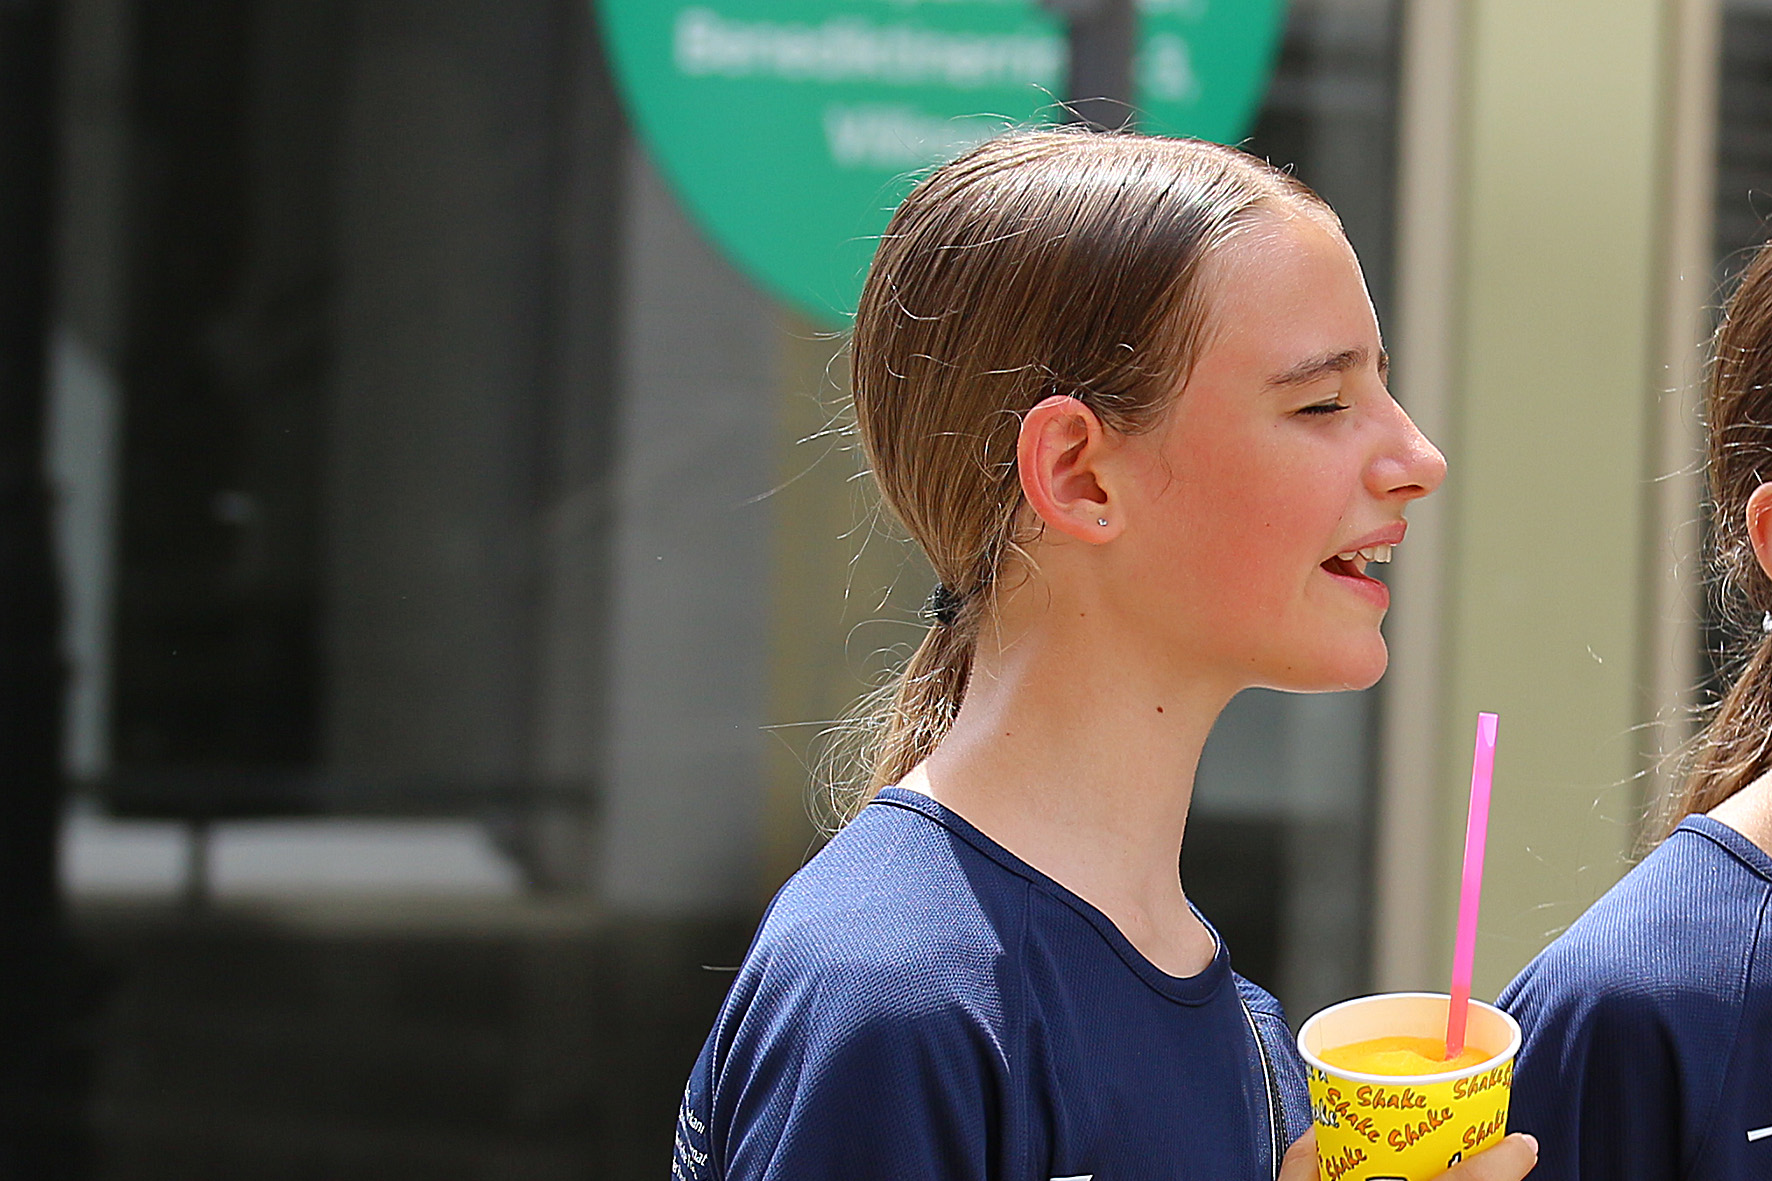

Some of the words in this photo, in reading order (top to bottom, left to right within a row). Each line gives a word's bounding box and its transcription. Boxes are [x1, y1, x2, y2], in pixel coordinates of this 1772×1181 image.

[1356, 1085, 1427, 1110] Shake
[1453, 1067, 1503, 1100] Shake
[1326, 1088, 1381, 1143] Shake
[1387, 1106, 1454, 1152] Shake
